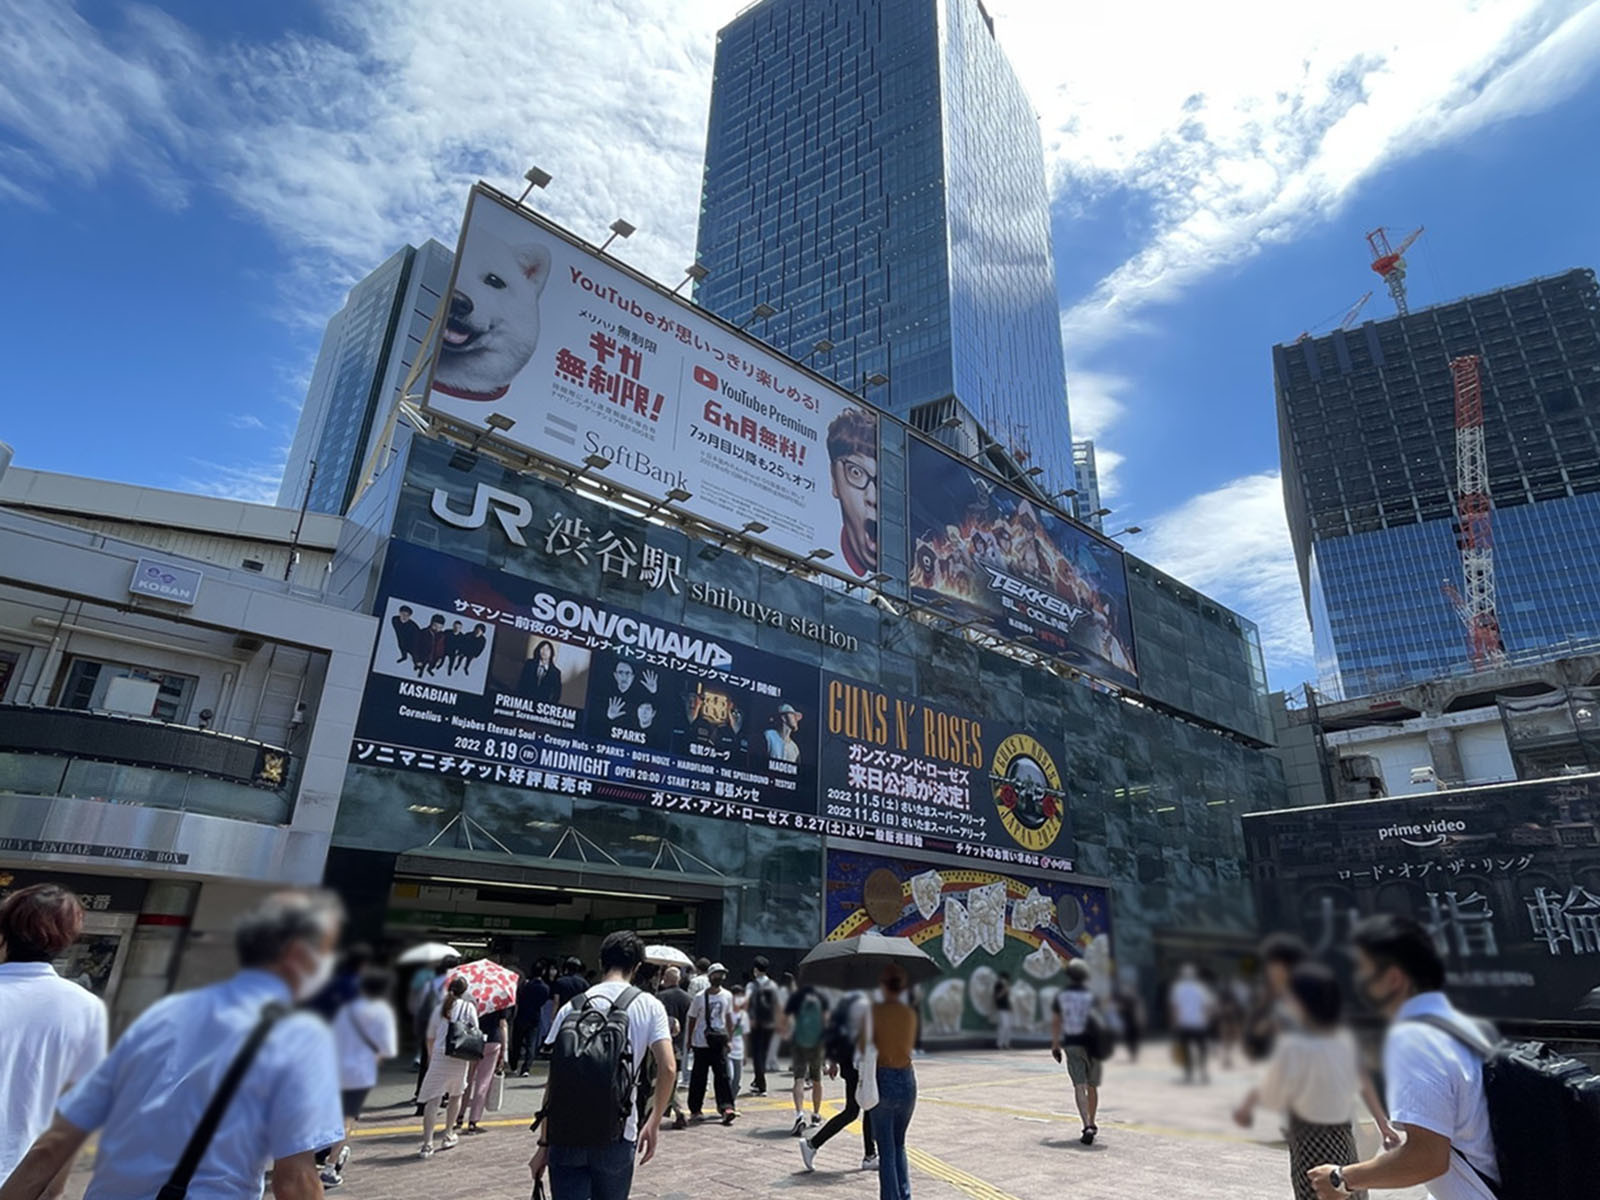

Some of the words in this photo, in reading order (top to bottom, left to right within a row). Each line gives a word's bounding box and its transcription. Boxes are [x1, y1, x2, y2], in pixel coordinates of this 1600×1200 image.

[569, 266, 820, 414] YouTubeが思いっきり楽しめる!
[579, 310, 657, 354] メリハリ無制限
[589, 331, 642, 380] ギガ
[555, 348, 664, 422] 無制限!
[721, 379, 767, 416] YouTube
[769, 404, 818, 442] Premium
[584, 431, 687, 490] SoftBank
[431, 482, 533, 547] JR
[545, 512, 682, 595] 渋谷駅
[138, 580, 191, 598] KOBAN
[985, 566, 1084, 622] TEKKEN
[692, 582, 783, 626] shibuya
[790, 615, 858, 651] station
[399, 682, 458, 706] KASABIAN
[495, 693, 534, 713] PRIMAL
[537, 702, 577, 721] SCREAM
[399, 705, 442, 723] Cornelius
[451, 716, 486, 731] Nujabes
[487, 722, 517, 738] Eternal
[518, 728, 536, 741] Soul
[544, 734, 571, 749] Creepy
[571, 739, 589, 751] Nuts
[596, 744, 625, 757] SPARKS
[632, 751, 650, 763] BOYS
[610, 727, 647, 744] SPARKS
[828, 679, 888, 746] GUNS
[895, 699, 916, 750] N'
[923, 706, 983, 770] ROSES
[356, 742, 593, 796] ソニマニチケット好評販売中
[454, 736, 481, 751] 2022
[484, 738, 518, 761] 8.19
[540, 748, 611, 777] MIDNIGHT
[614, 766, 636, 779] OPEN
[637, 769, 660, 783] 20:00
[667, 775, 690, 789] START
[691, 780, 711, 792] 21:30
[714, 780, 760, 802] 幕張メッセ
[848, 743, 970, 786] ガンズ・アンド・ローゼズ
[848, 763, 971, 811] 来日公演が決定!
[650, 791, 790, 827] ガンズ・アンド・ローゼズ
[827, 788, 852, 801] 2022
[854, 791, 899, 811] 11.5(土)
[827, 804, 852, 818] 2022
[854, 807, 899, 826] 11.6(日)
[41, 841, 92, 856] EKIMAE
[103, 846, 149, 861] POLICE
[156, 852, 181, 865] BOX
[1378, 822, 1422, 840] prime
[1423, 819, 1466, 833] video
[1338, 854, 1535, 881] ロード・オブ・ザ・リング
